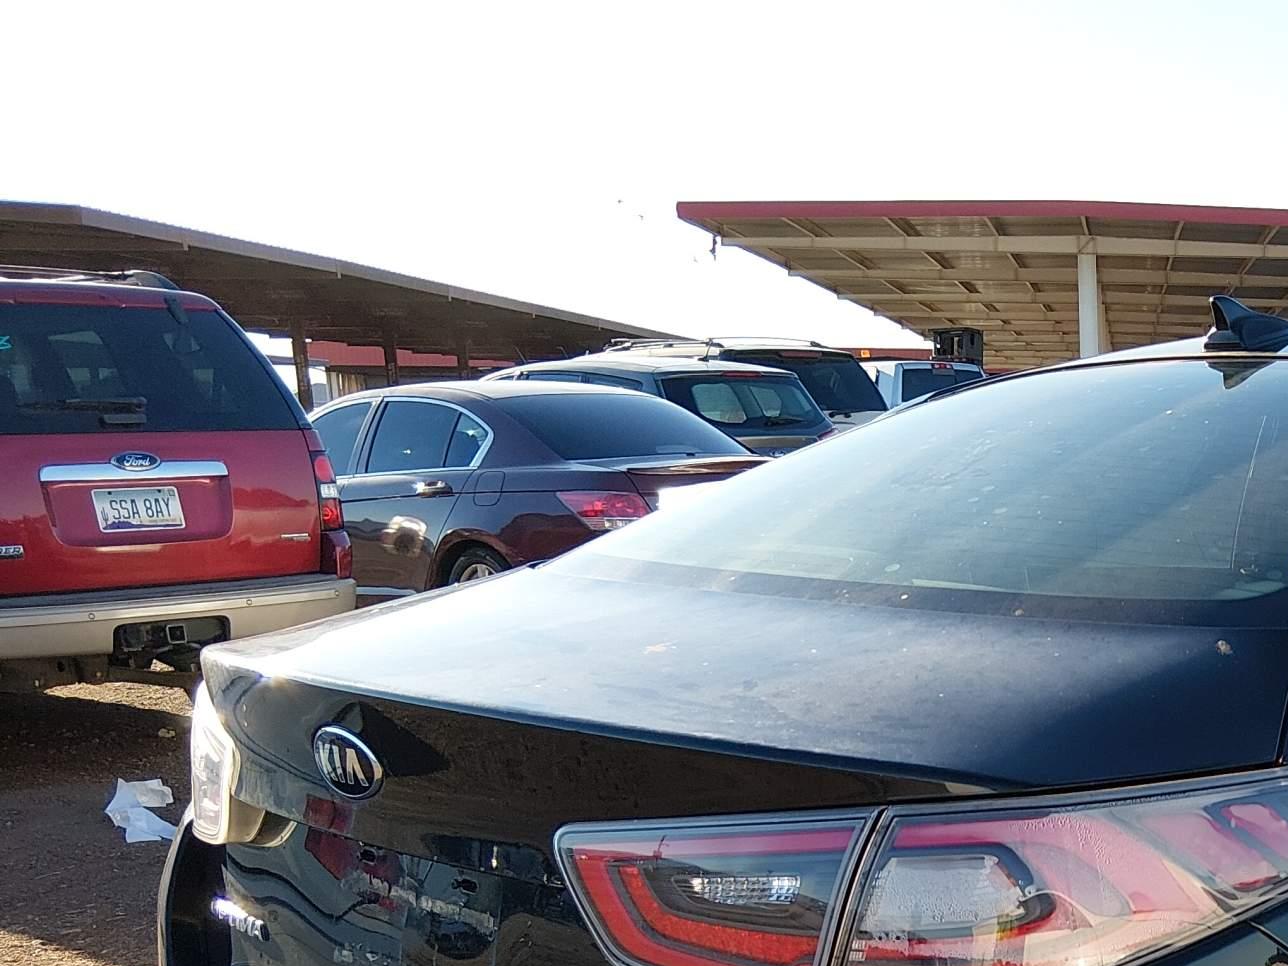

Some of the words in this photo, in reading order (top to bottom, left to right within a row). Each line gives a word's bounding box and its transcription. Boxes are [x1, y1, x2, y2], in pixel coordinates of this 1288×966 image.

[123, 454, 151, 467] Ford
[109, 498, 141, 520] SSA
[143, 497, 172, 519] 8AY
[317, 740, 369, 787] KIA
